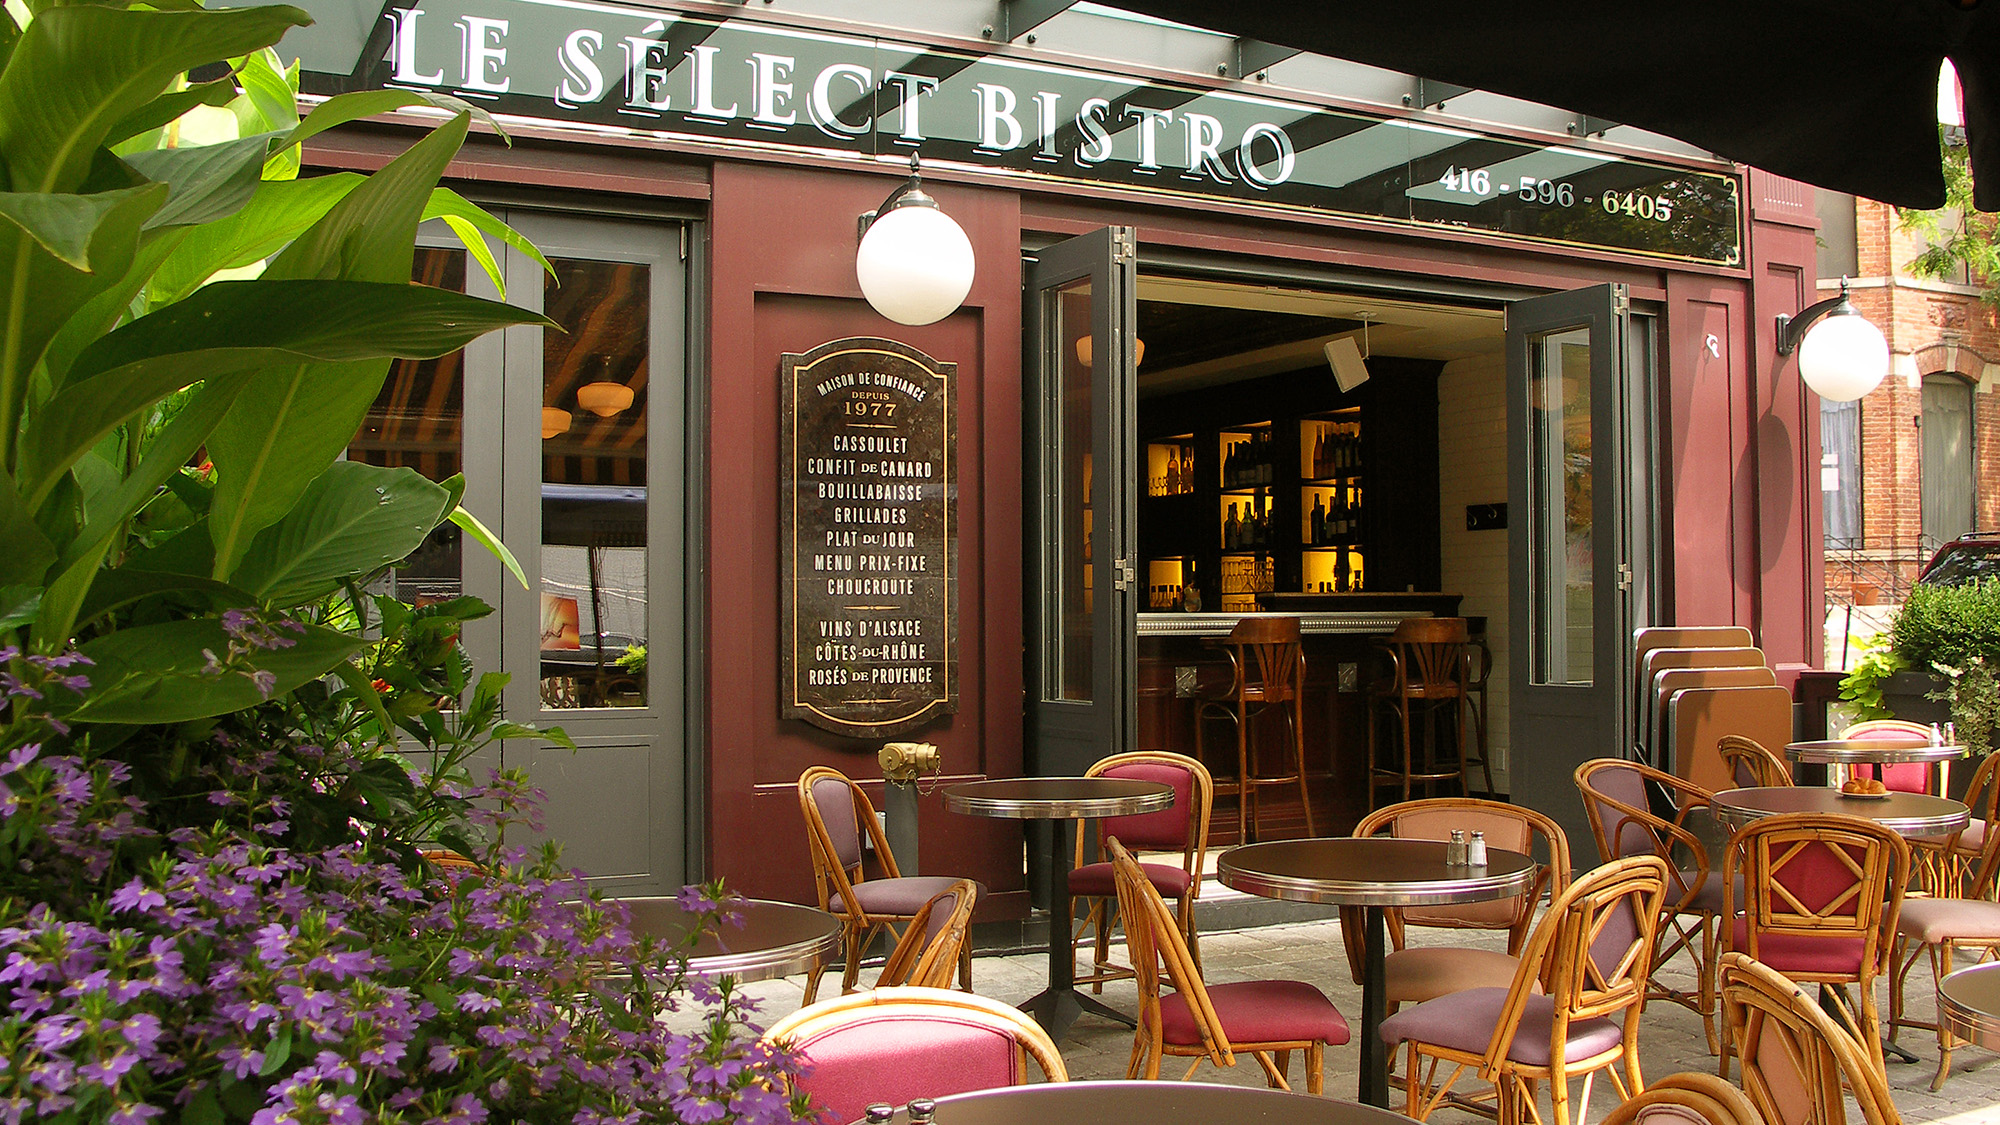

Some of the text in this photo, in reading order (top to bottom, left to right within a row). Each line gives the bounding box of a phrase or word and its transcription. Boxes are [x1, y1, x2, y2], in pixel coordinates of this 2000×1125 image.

[383, 7, 1297, 190] LE SÉLECT BISTRO
[1438, 164, 1491, 195] 416
[1518, 176, 1575, 207] 596
[1602, 189, 1673, 222] 6405
[816, 372, 928, 402] MAISON DE CONFIANCE
[851, 391, 890, 400] DEPUIS
[844, 401, 897, 417] 1977
[833, 435, 908, 454] CASSOULET
[807, 458, 932, 478] CONFIT DE CANARD
[818, 482, 922, 501] BOUILLABAISSE
[834, 507, 907, 524] GRILLADES
[826, 531, 915, 548] PLAT DU JOUR
[814, 555, 927, 572] MENU PRIX-FIXE
[827, 579, 914, 595] CHOUCROUTE
[819, 620, 922, 637] VINS D'ALSACE
[815, 641, 926, 662] CÔTES-DU-RHÔNE
[809, 666, 933, 686] ROSÉS DE PROVENCE
